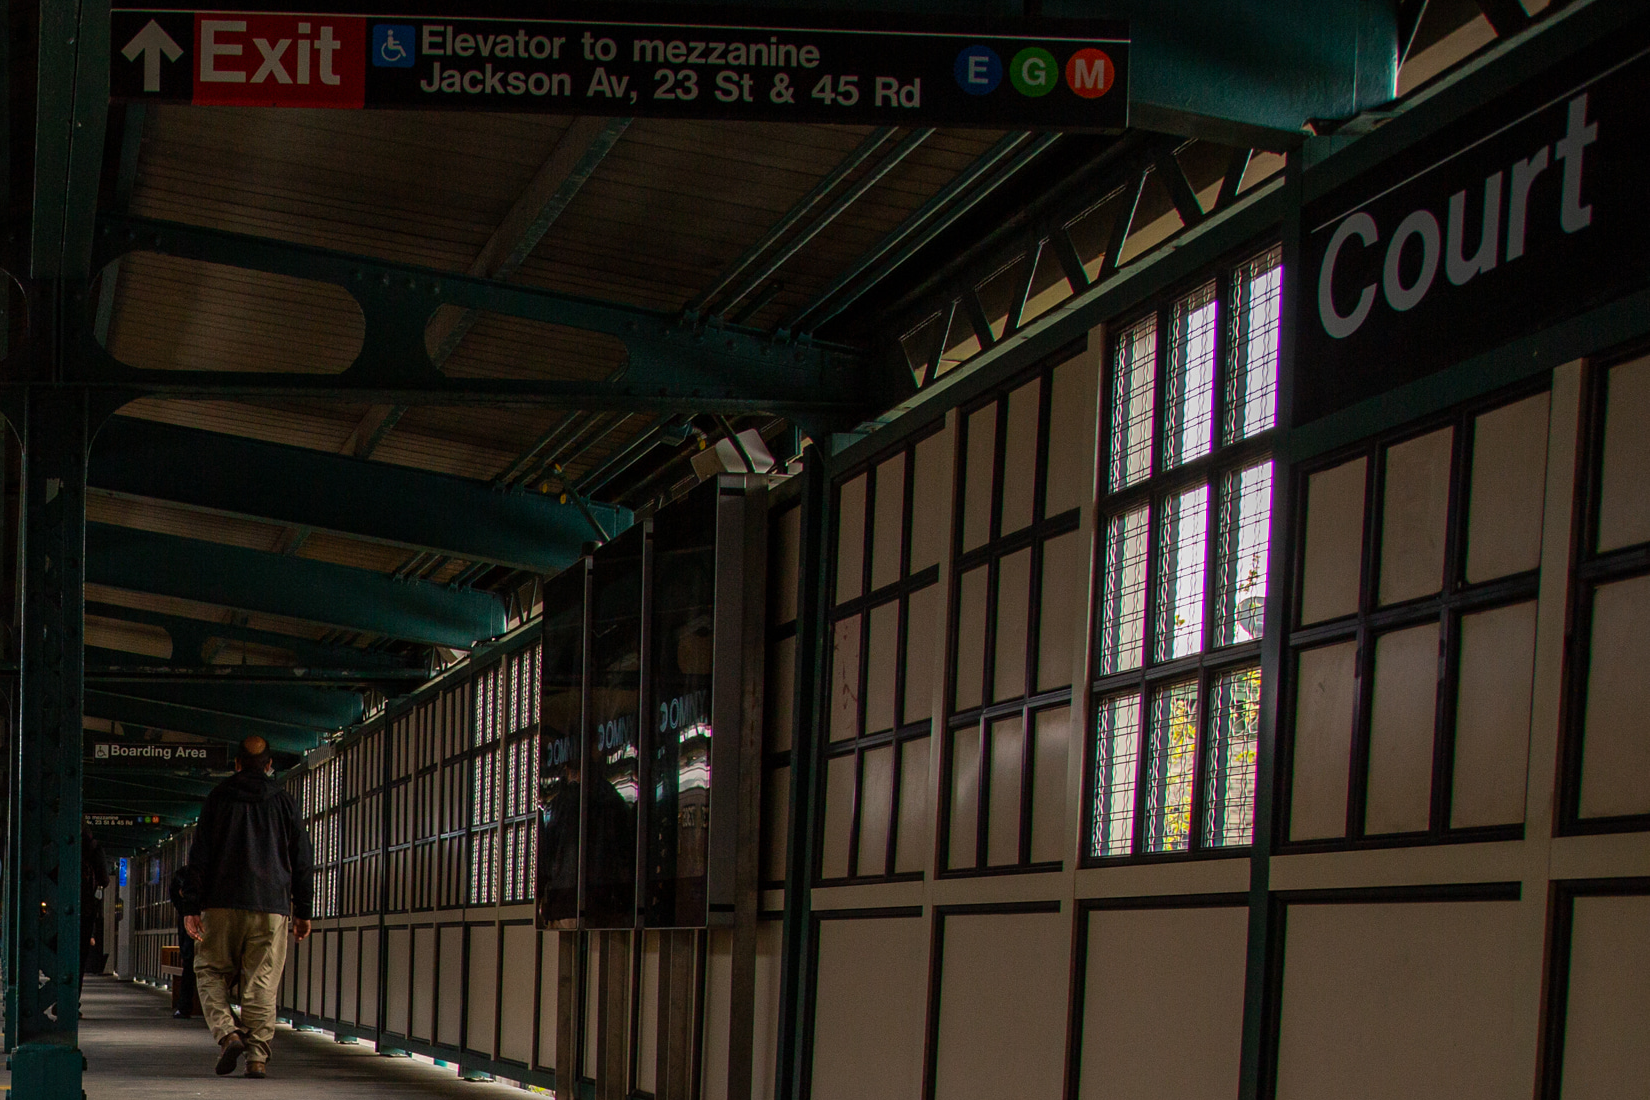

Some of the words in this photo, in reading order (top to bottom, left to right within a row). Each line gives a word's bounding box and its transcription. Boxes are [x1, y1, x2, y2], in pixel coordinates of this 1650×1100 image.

[199, 20, 341, 85] Exit
[421, 25, 566, 60] Elevator
[582, 31, 616, 62] to
[633, 36, 820, 68] mezzanine
[420, 63, 572, 97] Jackson
[587, 67, 638, 104] Av,
[653, 69, 699, 101] 23
[715, 71, 753, 102] St
[770, 73, 795, 104] &
[811, 75, 859, 107] 45
[875, 77, 921, 108] Rd
[967, 56, 990, 85] E
[1021, 57, 1047, 87] G
[1073, 59, 1105, 90] M
[1318, 93, 1598, 339] Court
[669, 689, 707, 729] OMNY
[111, 744, 171, 760] Boarding
[175, 746, 207, 758] Area
